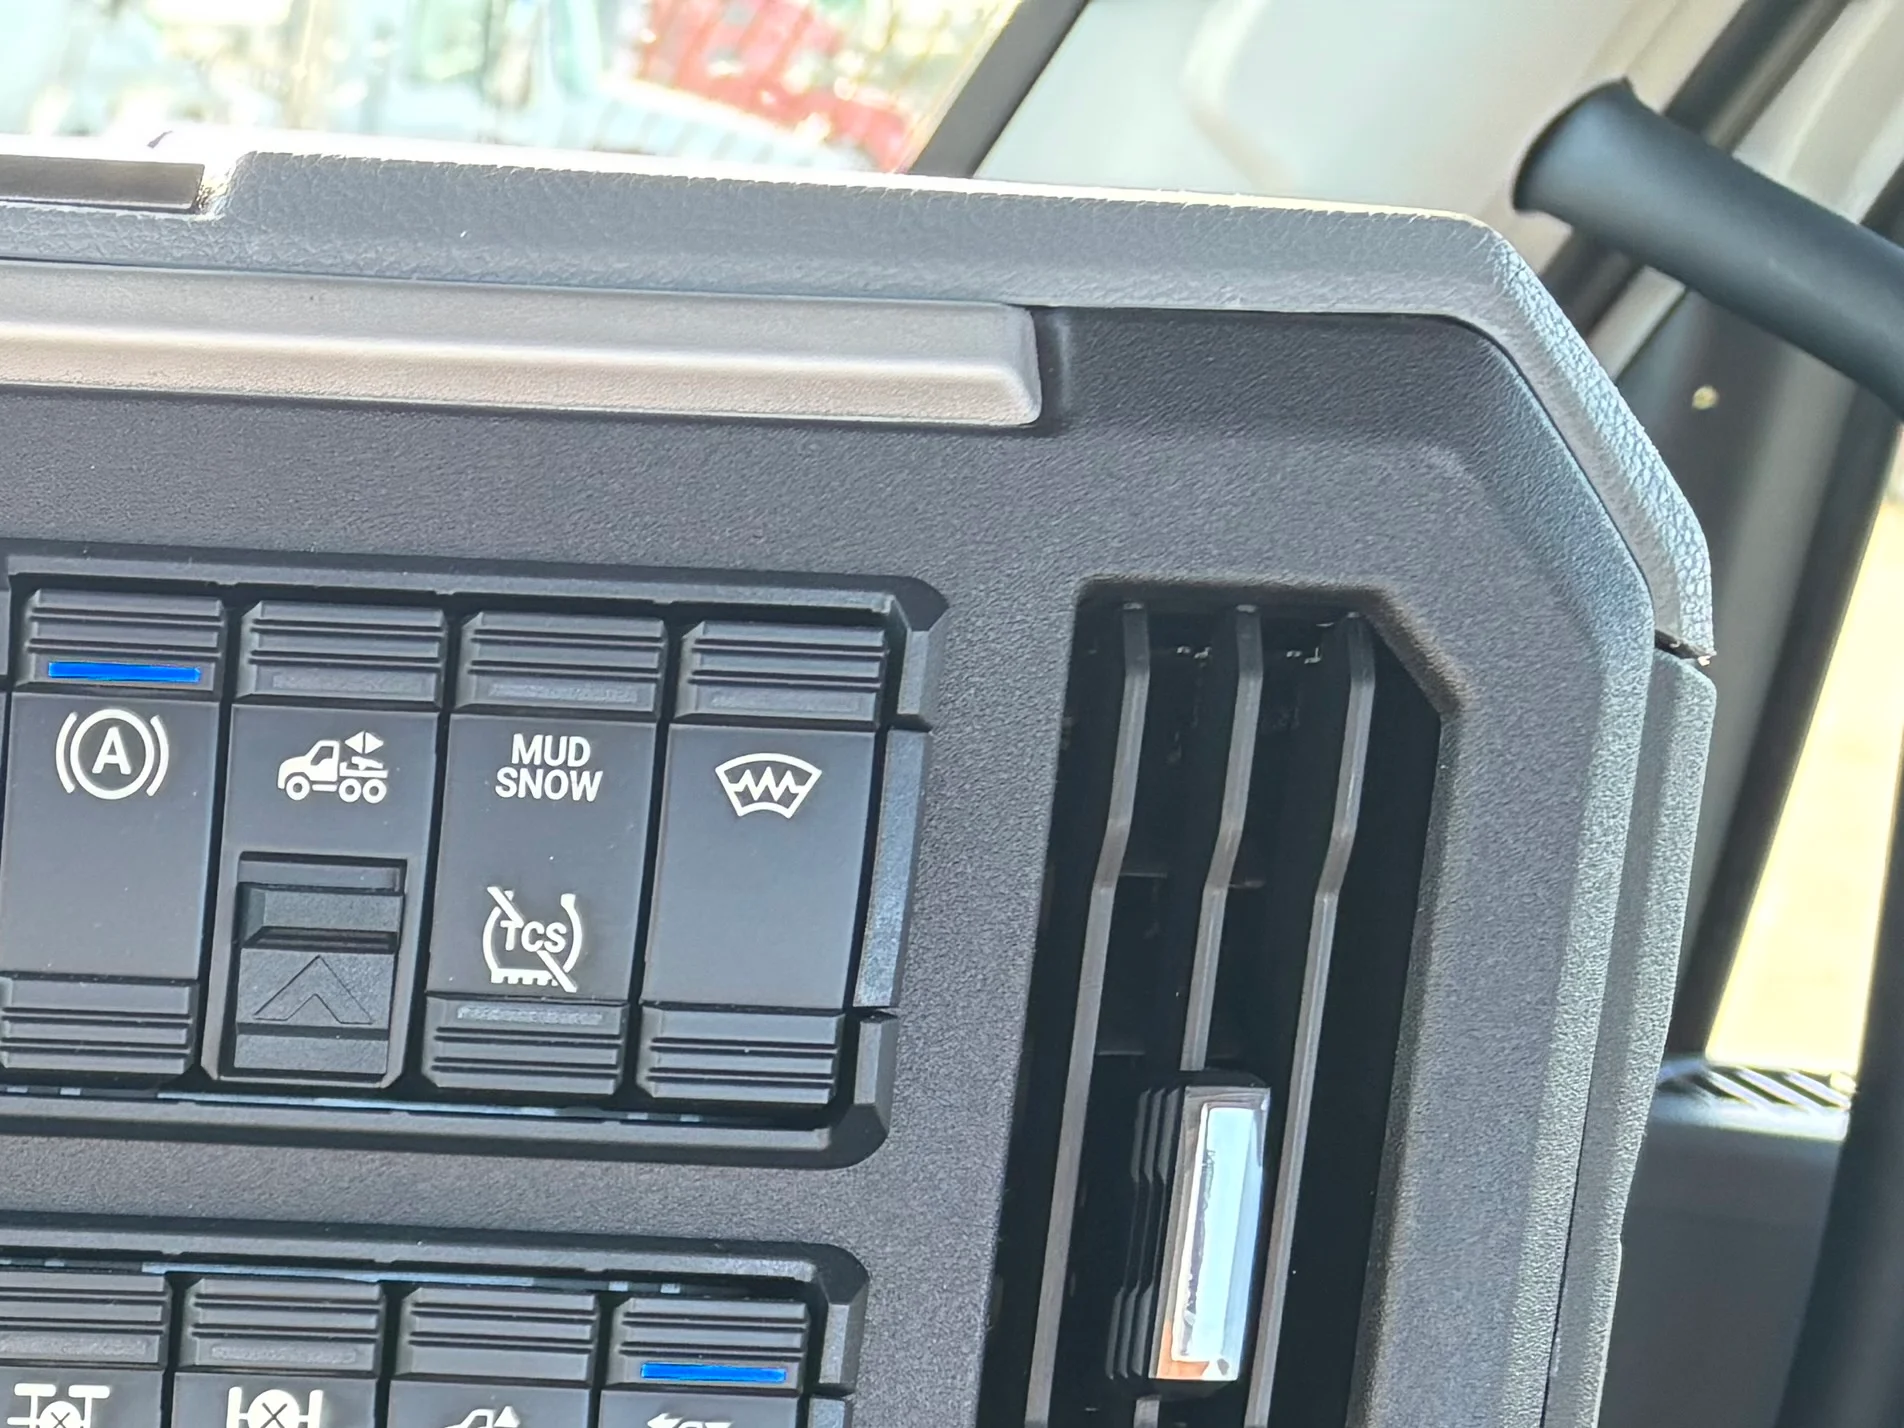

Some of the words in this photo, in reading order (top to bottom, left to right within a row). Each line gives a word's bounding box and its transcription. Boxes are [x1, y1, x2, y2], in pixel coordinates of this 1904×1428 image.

[510, 734, 591, 768] MUD
[495, 766, 602, 802] SNOW
[500, 920, 567, 953] TCS
